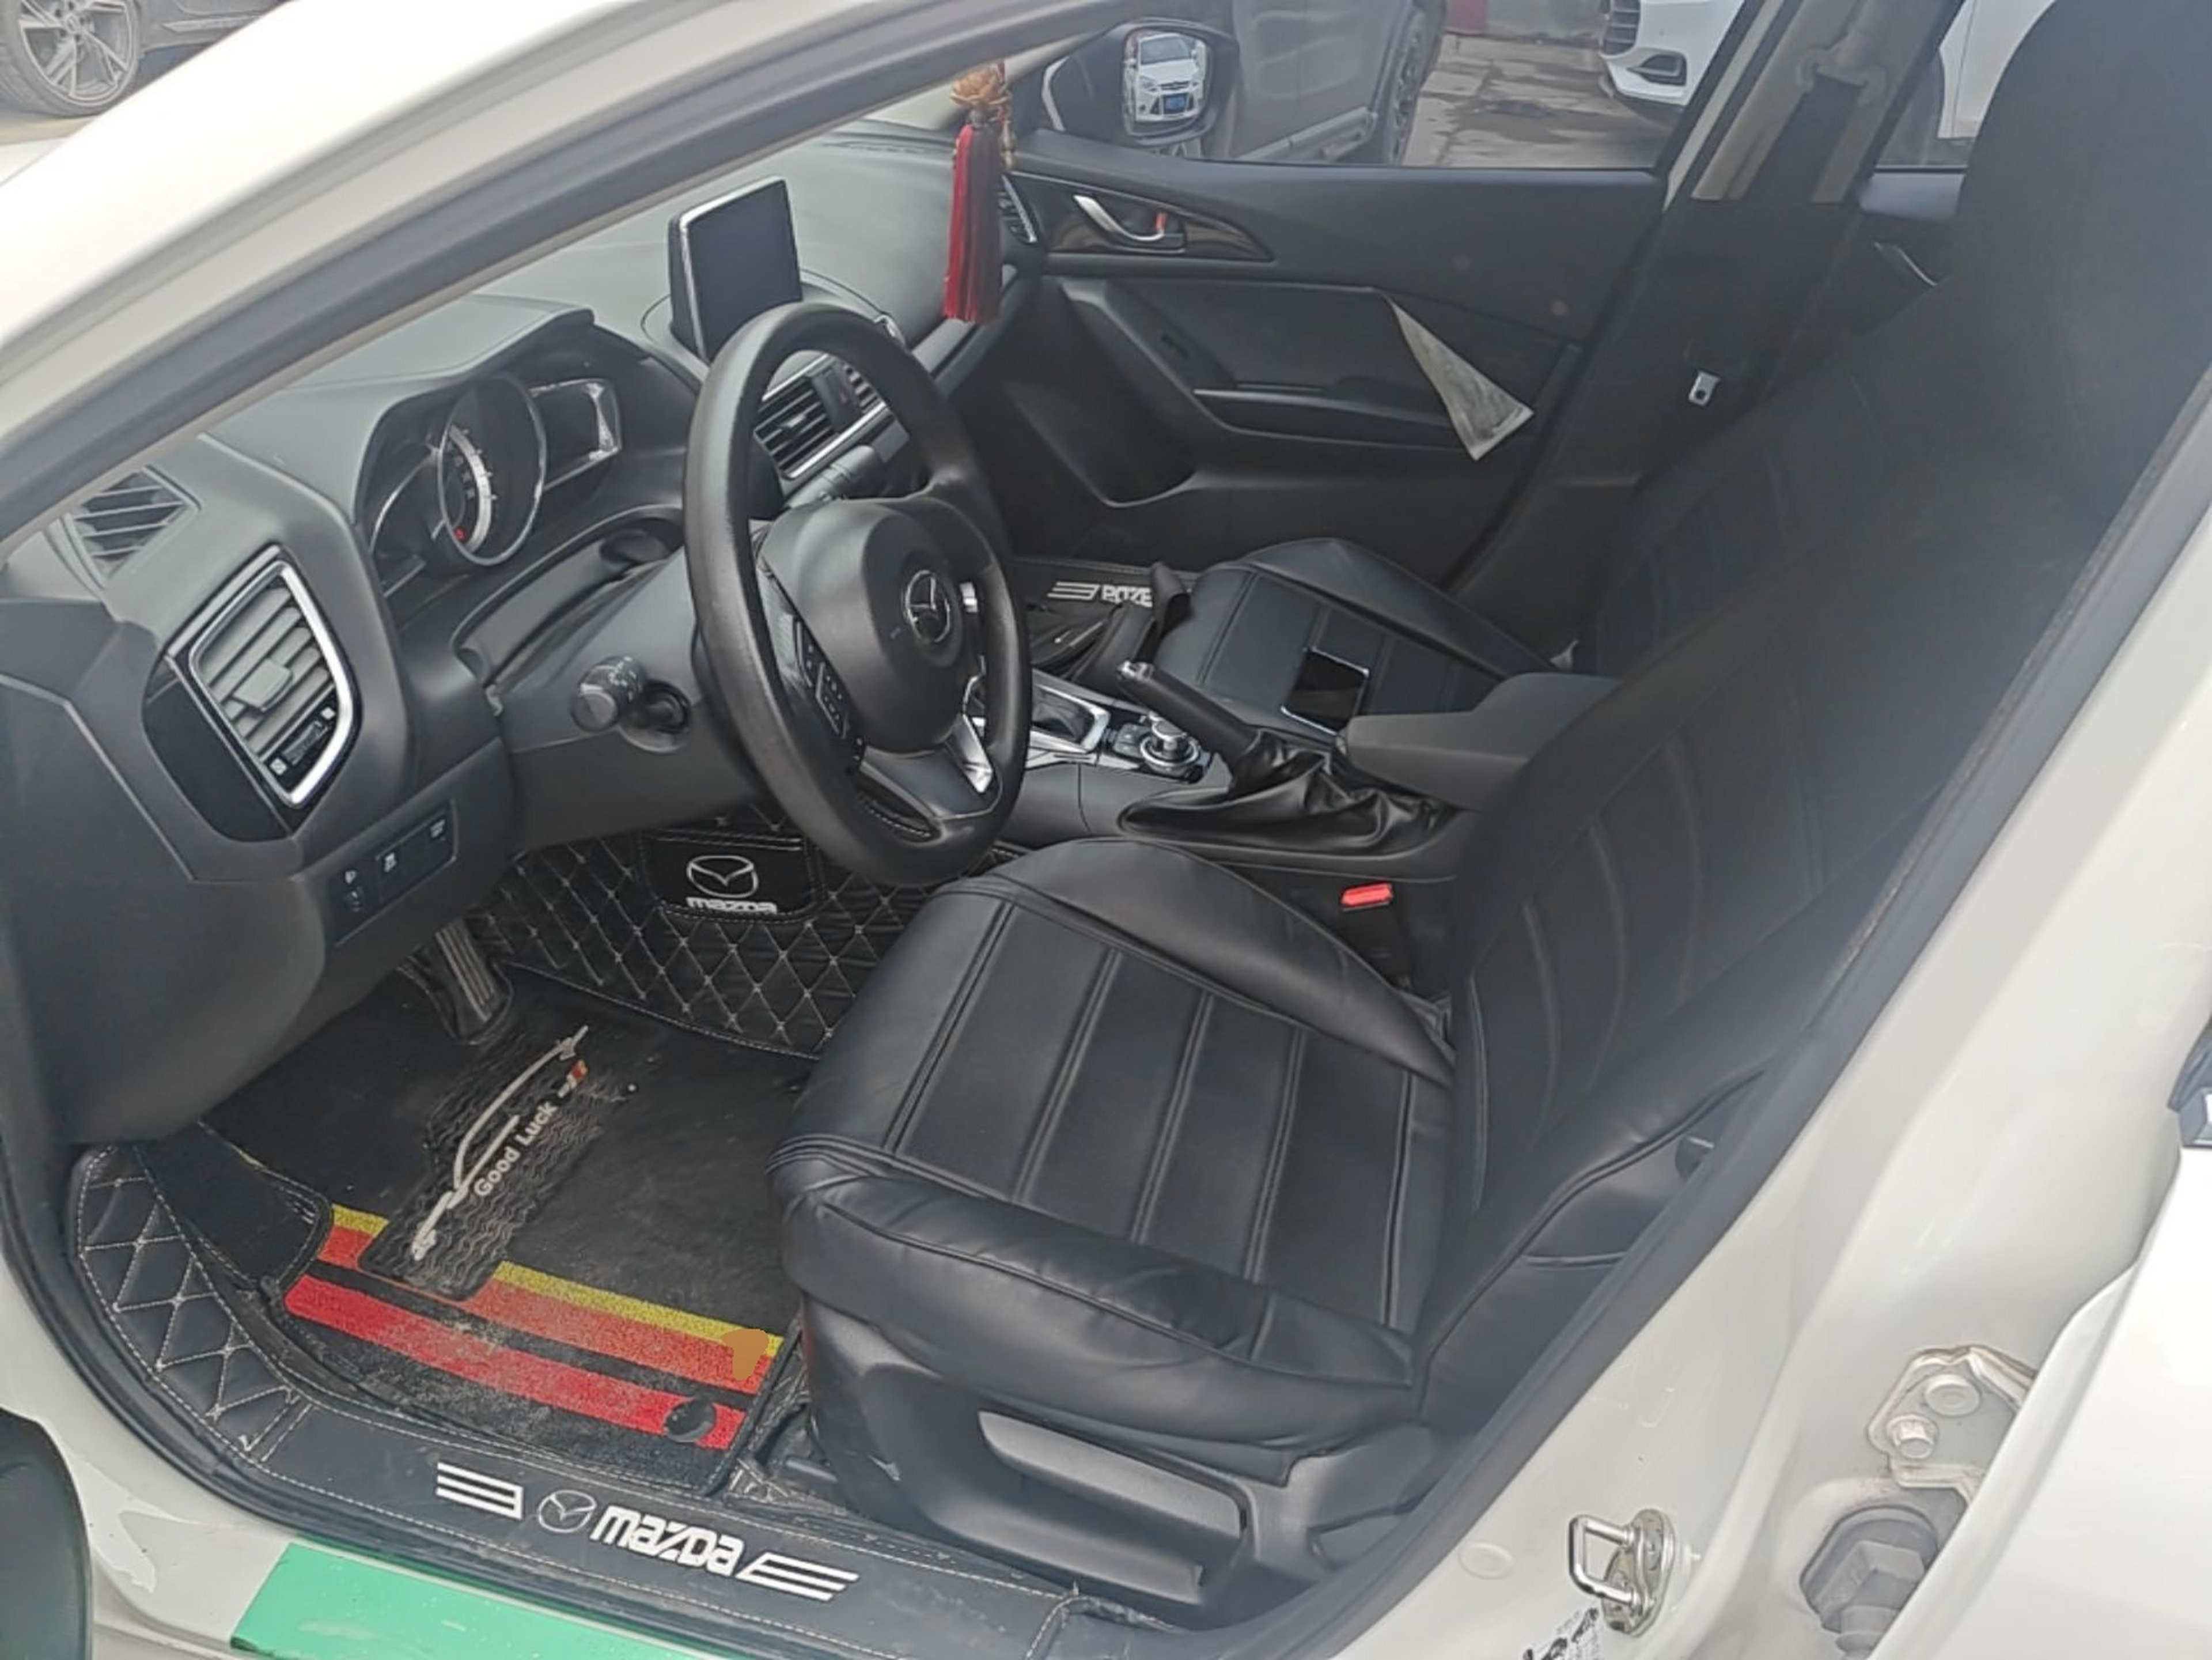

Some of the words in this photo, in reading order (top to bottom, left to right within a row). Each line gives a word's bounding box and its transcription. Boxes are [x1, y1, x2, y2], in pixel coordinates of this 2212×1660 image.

[474, 1147, 520, 1196] Good
[514, 1101, 558, 1146] Luck
[590, 1505, 745, 1576] mazda
